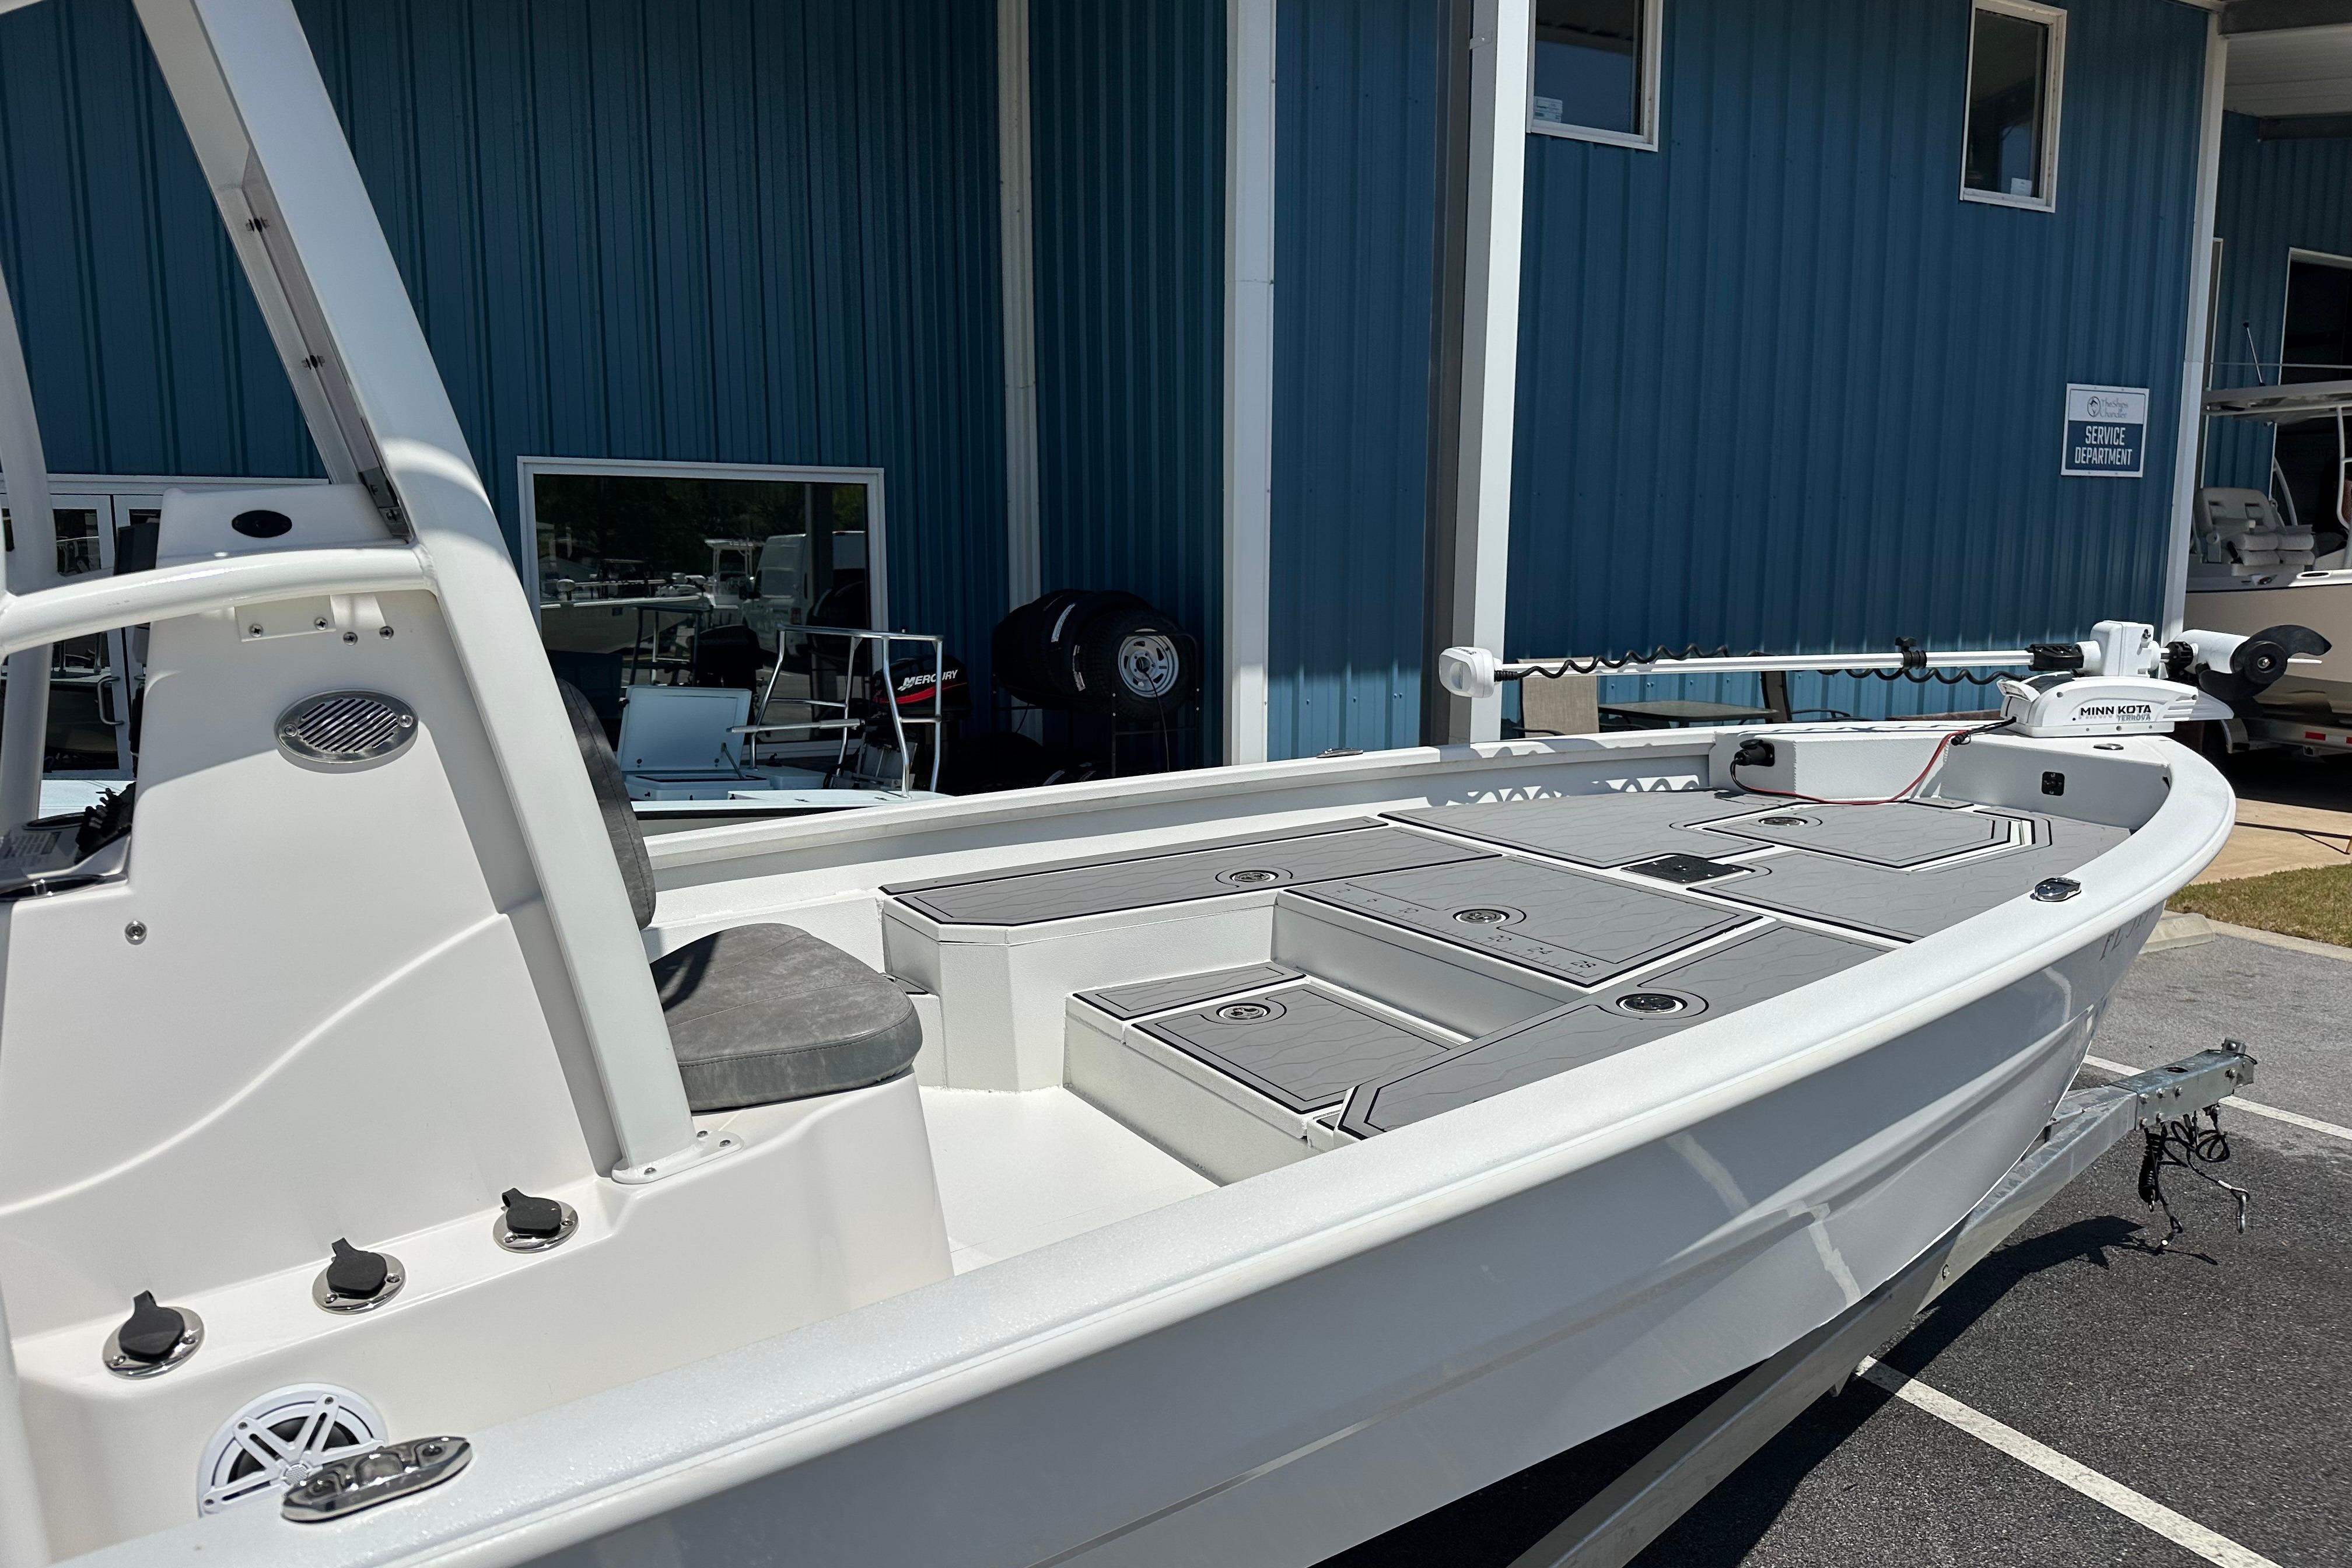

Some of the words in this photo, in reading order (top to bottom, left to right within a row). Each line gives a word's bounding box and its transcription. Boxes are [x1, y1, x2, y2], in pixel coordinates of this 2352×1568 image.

[2085, 425, 2126, 445] SERVICE
[2074, 446, 2133, 466] DEPARTMENT
[2080, 706, 2115, 716] MINN
[2118, 704, 2152, 714] KOTA
